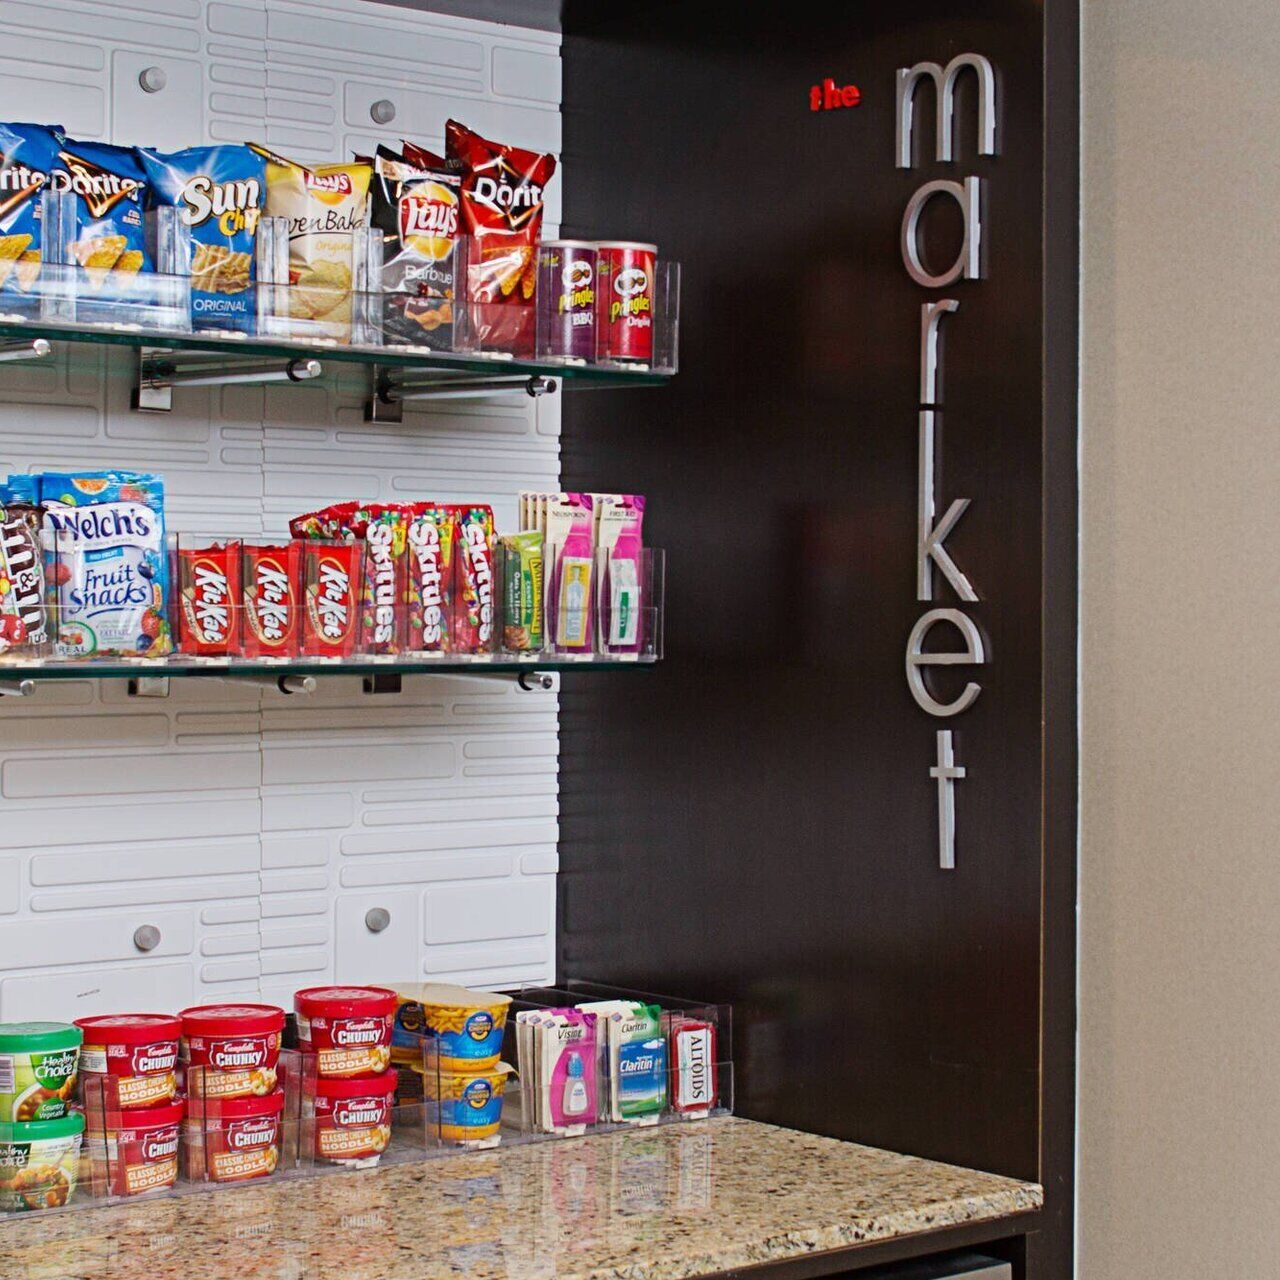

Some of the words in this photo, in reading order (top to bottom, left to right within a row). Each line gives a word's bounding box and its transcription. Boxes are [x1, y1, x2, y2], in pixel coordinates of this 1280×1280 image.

[810, 79, 861, 111] the
[183, 175, 261, 226] Sun
[475, 177, 542, 207] Dorit
[220, 209, 261, 237] Chip
[326, 207, 366, 231] Bak
[193, 299, 248, 313] ORIGINAL
[895, 53, 994, 869] market
[48, 508, 150, 541] Welch's
[86, 564, 134, 593] Fruit
[367, 523, 395, 644] Skittles
[408, 521, 441, 644] Skittles
[462, 522, 493, 642] Skittles
[70, 583, 147, 615] Snacks
[621, 1022, 648, 1034] Claritin
[620, 1059, 653, 1073] Claritin
[690, 1036, 705, 1099] ALTOIDS
[200, 1080, 252, 1094] OODLE
[41, 1102, 65, 1114] Country
[148, 1138, 178, 1158] CHUN
